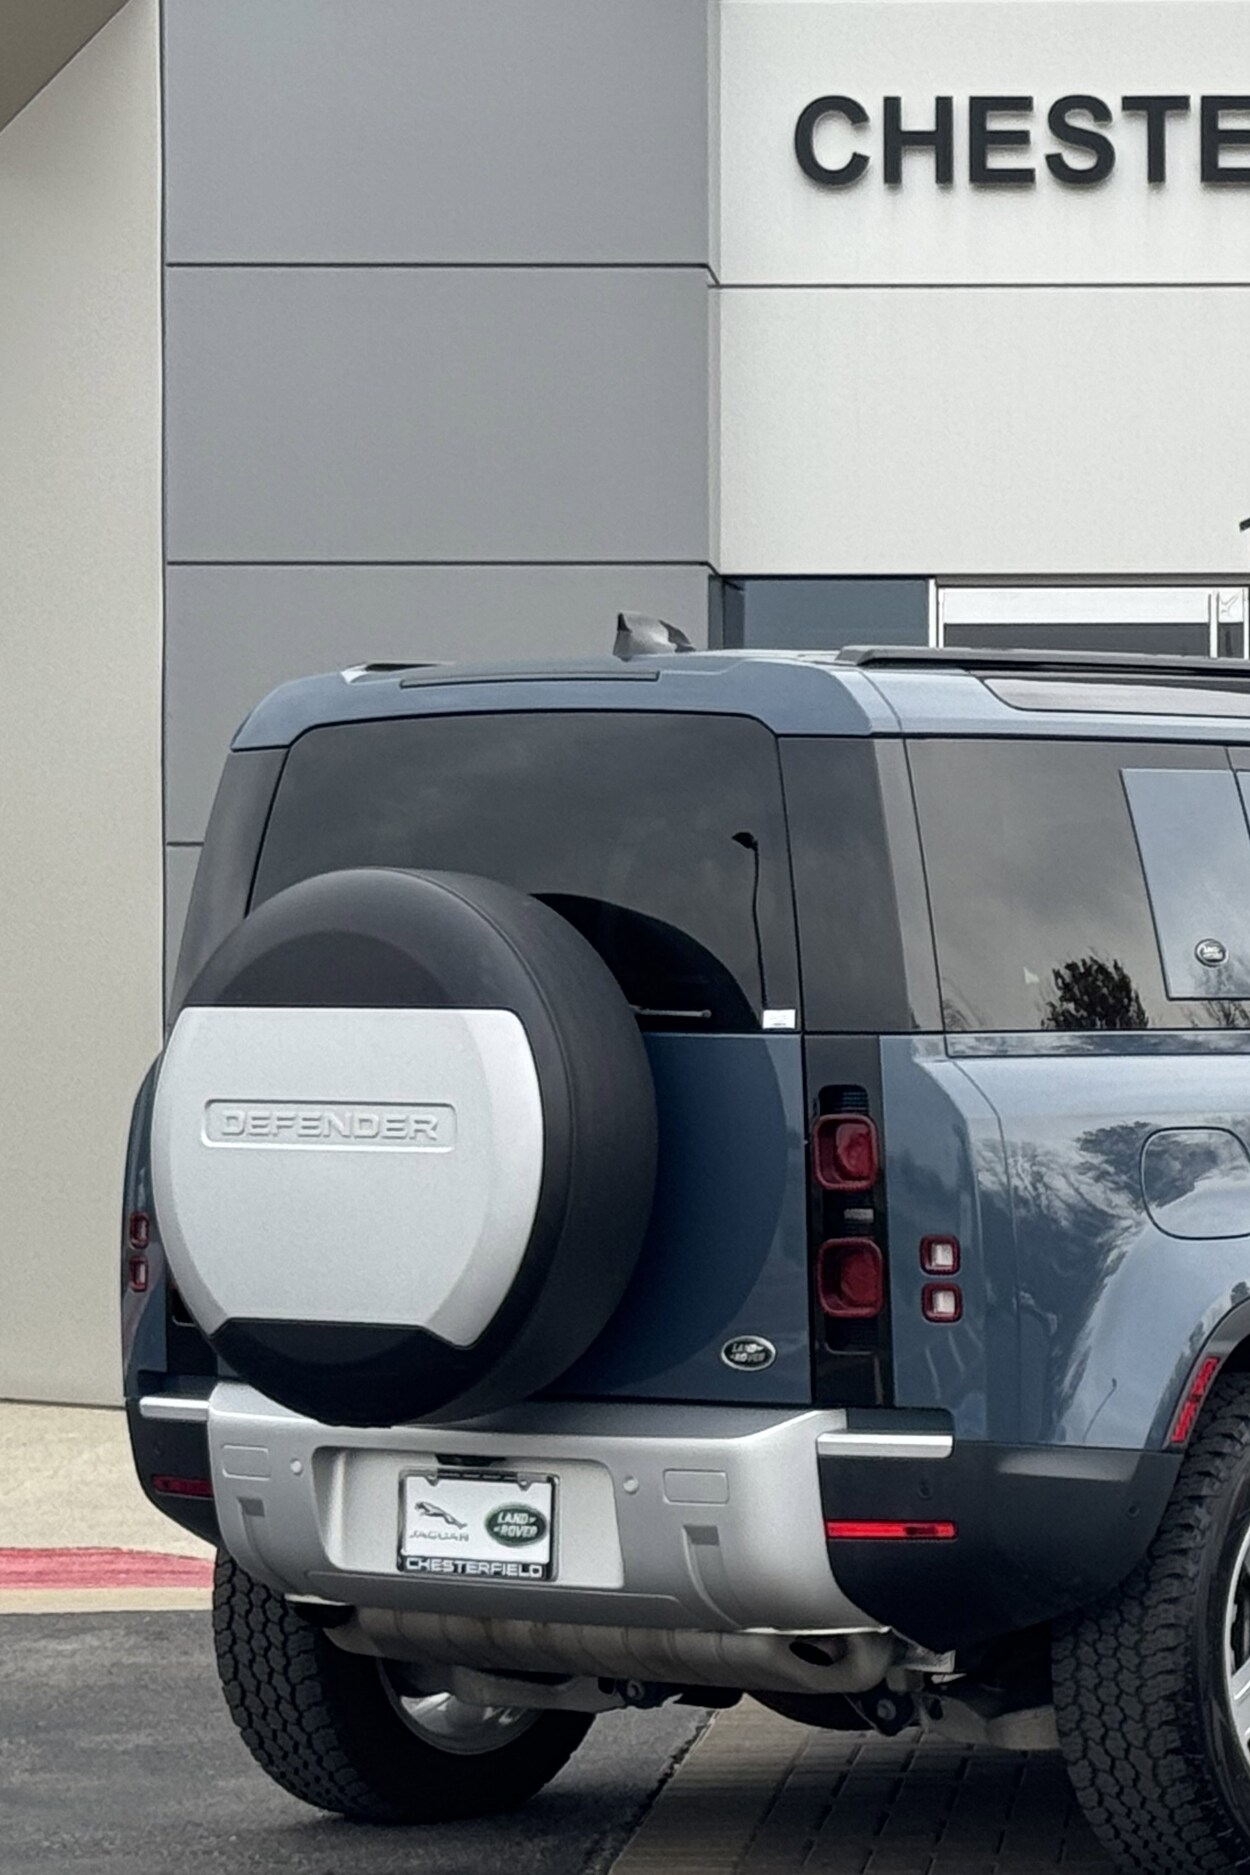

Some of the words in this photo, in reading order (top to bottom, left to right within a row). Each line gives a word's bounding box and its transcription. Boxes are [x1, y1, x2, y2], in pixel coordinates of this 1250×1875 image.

[221, 1109, 439, 1141] DEFENDER
[497, 1511, 530, 1525] LAND
[409, 1529, 470, 1543] JAGUAR
[500, 1525, 538, 1538] ROVER
[405, 1558, 543, 1578] CHESTERFIELD
